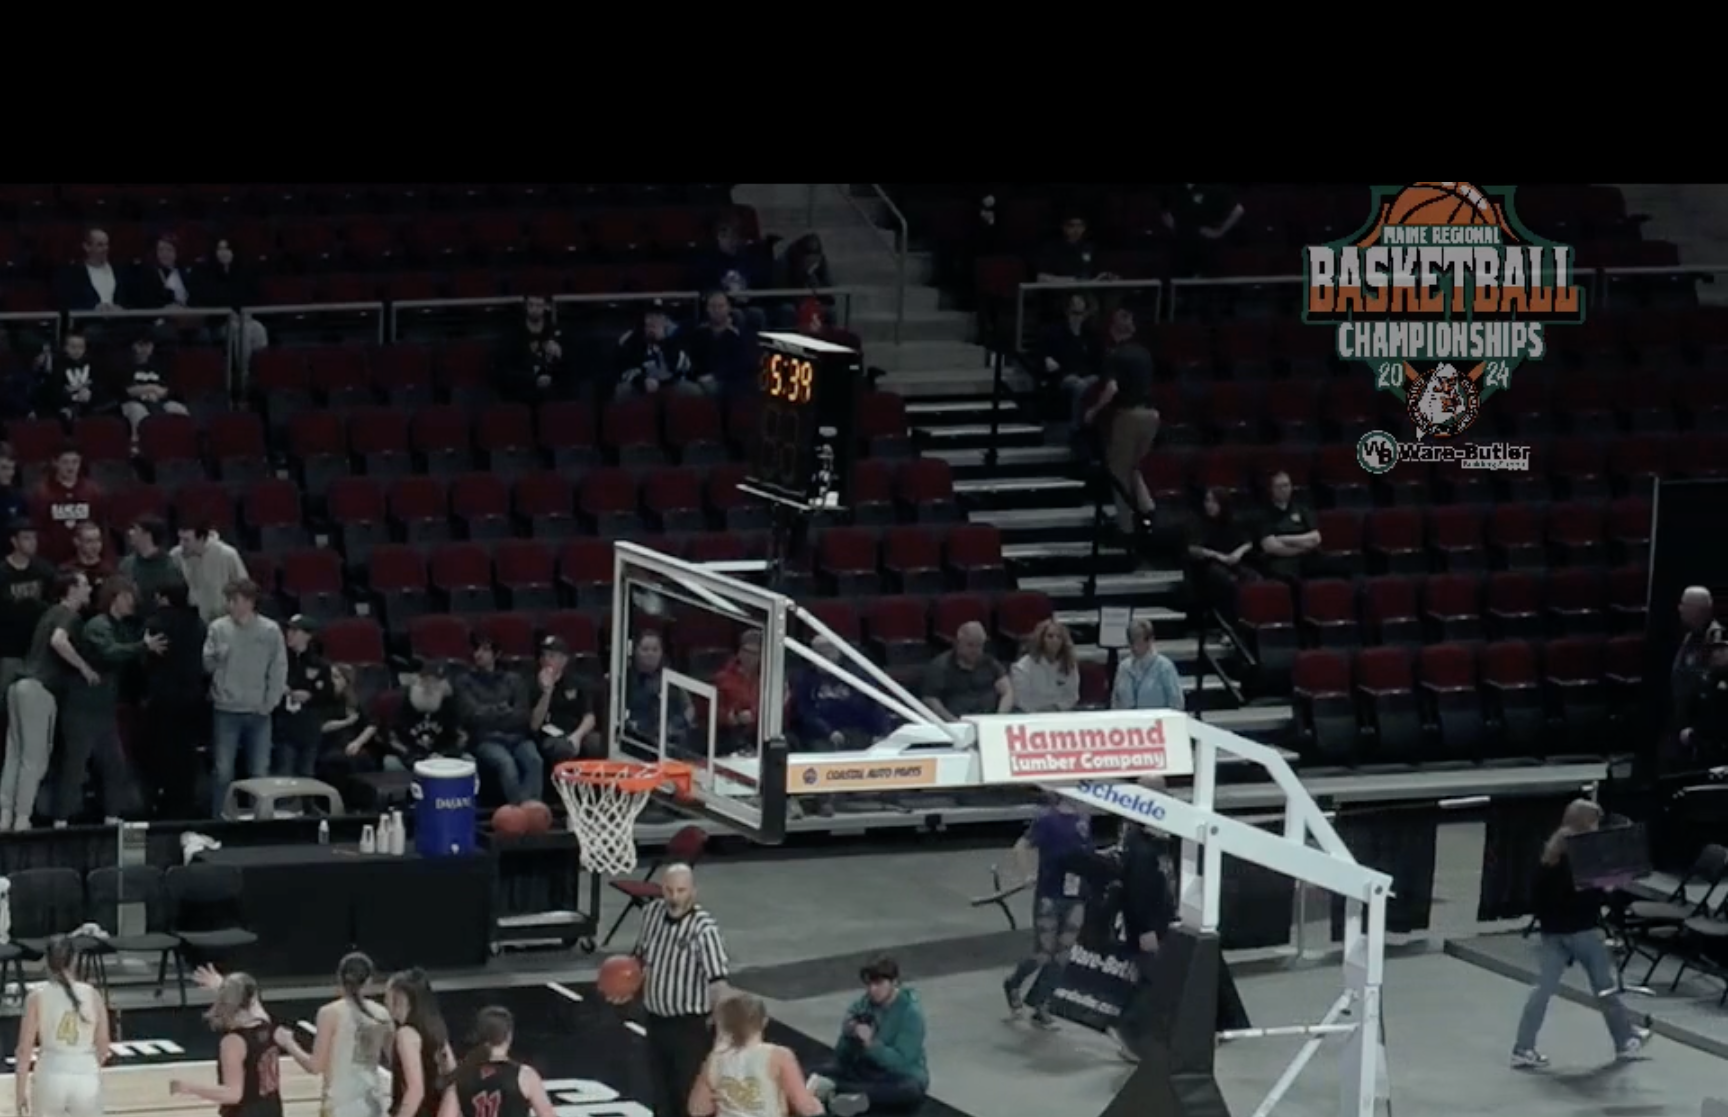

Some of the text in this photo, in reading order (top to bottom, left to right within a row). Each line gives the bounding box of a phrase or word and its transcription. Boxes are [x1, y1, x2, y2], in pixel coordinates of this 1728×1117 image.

[770, 354, 813, 402] 5:39
[1005, 718, 1166, 751] Hammond
[825, 765, 922, 780] COASTAL AUTO PARTS
[1012, 752, 1166, 772] Lumber Company
[1077, 778, 1166, 821] Schelde
[56, 1010, 80, 1046] 4
